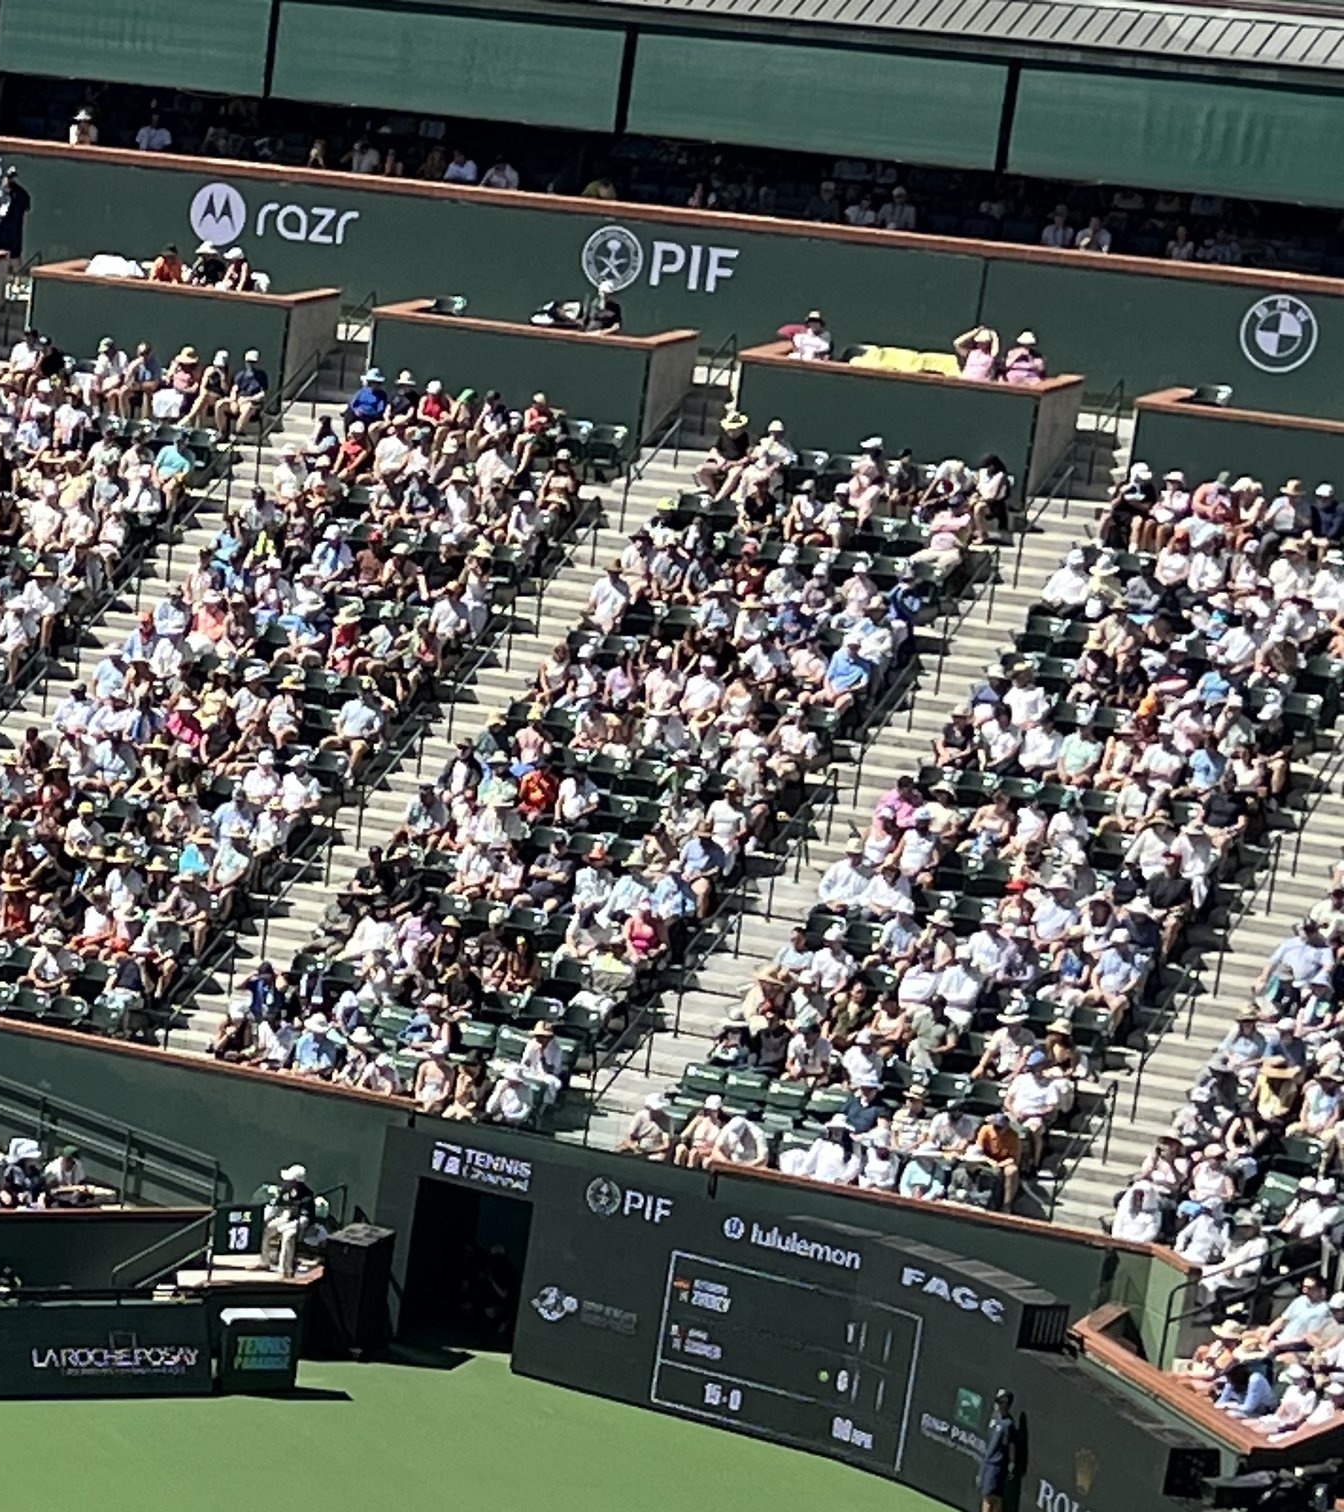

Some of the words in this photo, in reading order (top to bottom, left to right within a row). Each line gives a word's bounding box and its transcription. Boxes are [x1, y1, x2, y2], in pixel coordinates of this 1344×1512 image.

[256, 202, 360, 246] razr
[649, 241, 741, 293] PIF
[464, 1148, 533, 1177] TENNIS
[622, 1189, 675, 1224] PIF
[228, 1226, 250, 1251] 13
[750, 1222, 862, 1270] lululemon
[900, 1266, 1006, 1324] FAGE
